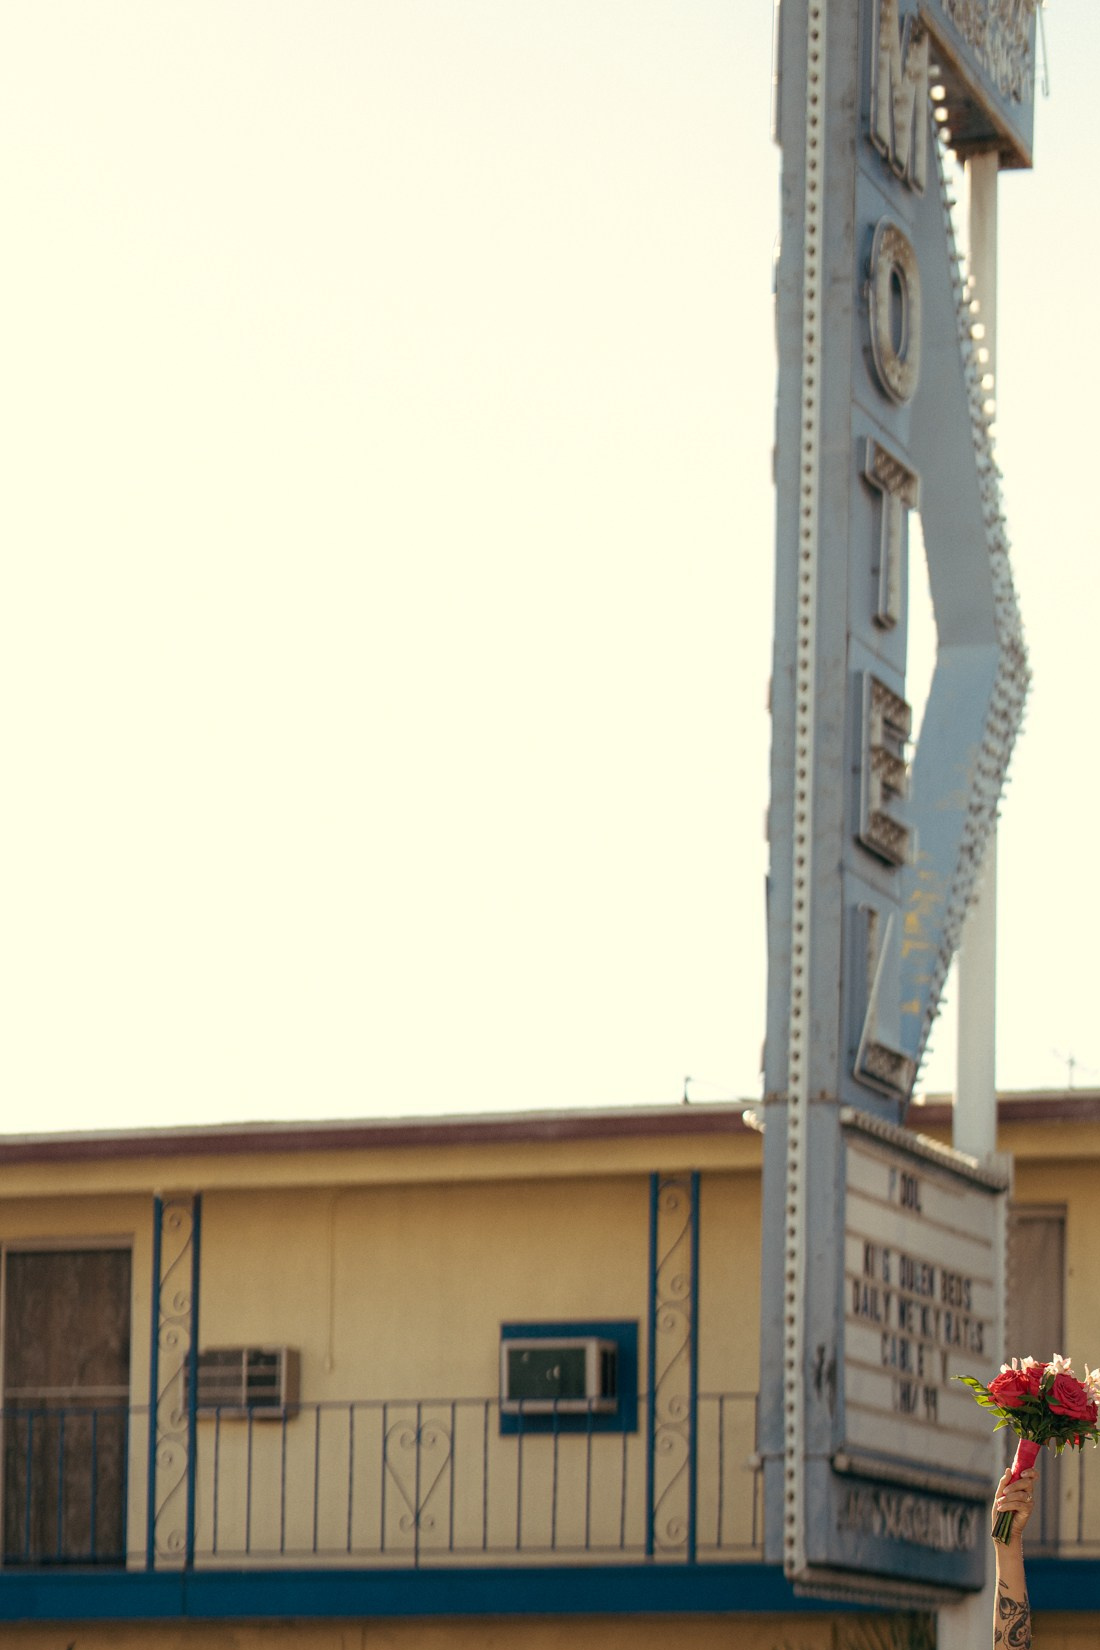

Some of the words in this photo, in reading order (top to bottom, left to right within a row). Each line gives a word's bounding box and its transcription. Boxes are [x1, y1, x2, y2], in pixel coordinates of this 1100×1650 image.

[853, 0, 929, 1100] MOTEL
[863, 1240, 891, 1284] KIG
[898, 1294, 940, 1339] WEKLY
